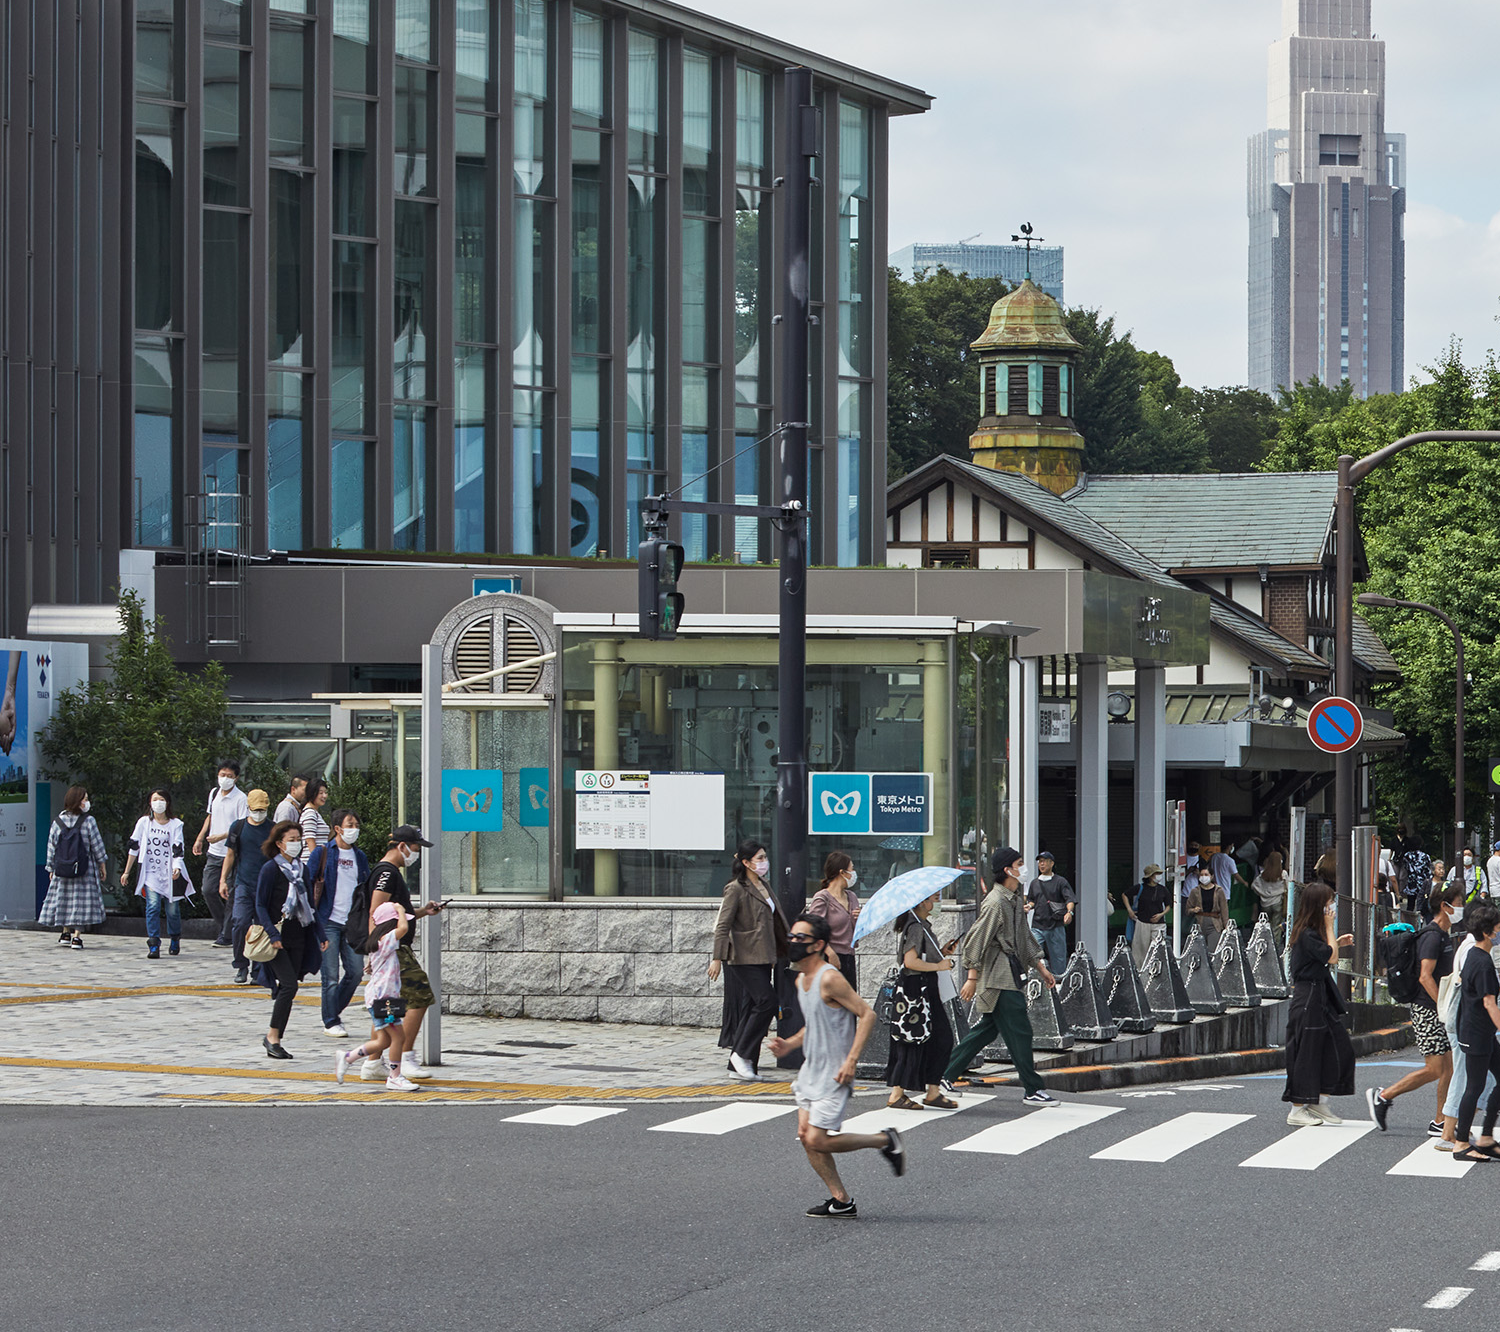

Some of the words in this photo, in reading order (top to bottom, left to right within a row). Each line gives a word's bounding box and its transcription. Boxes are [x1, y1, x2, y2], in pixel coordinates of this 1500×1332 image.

[877, 795, 925, 805] 東京メトロ
[880, 806, 900, 815] Tokyo
